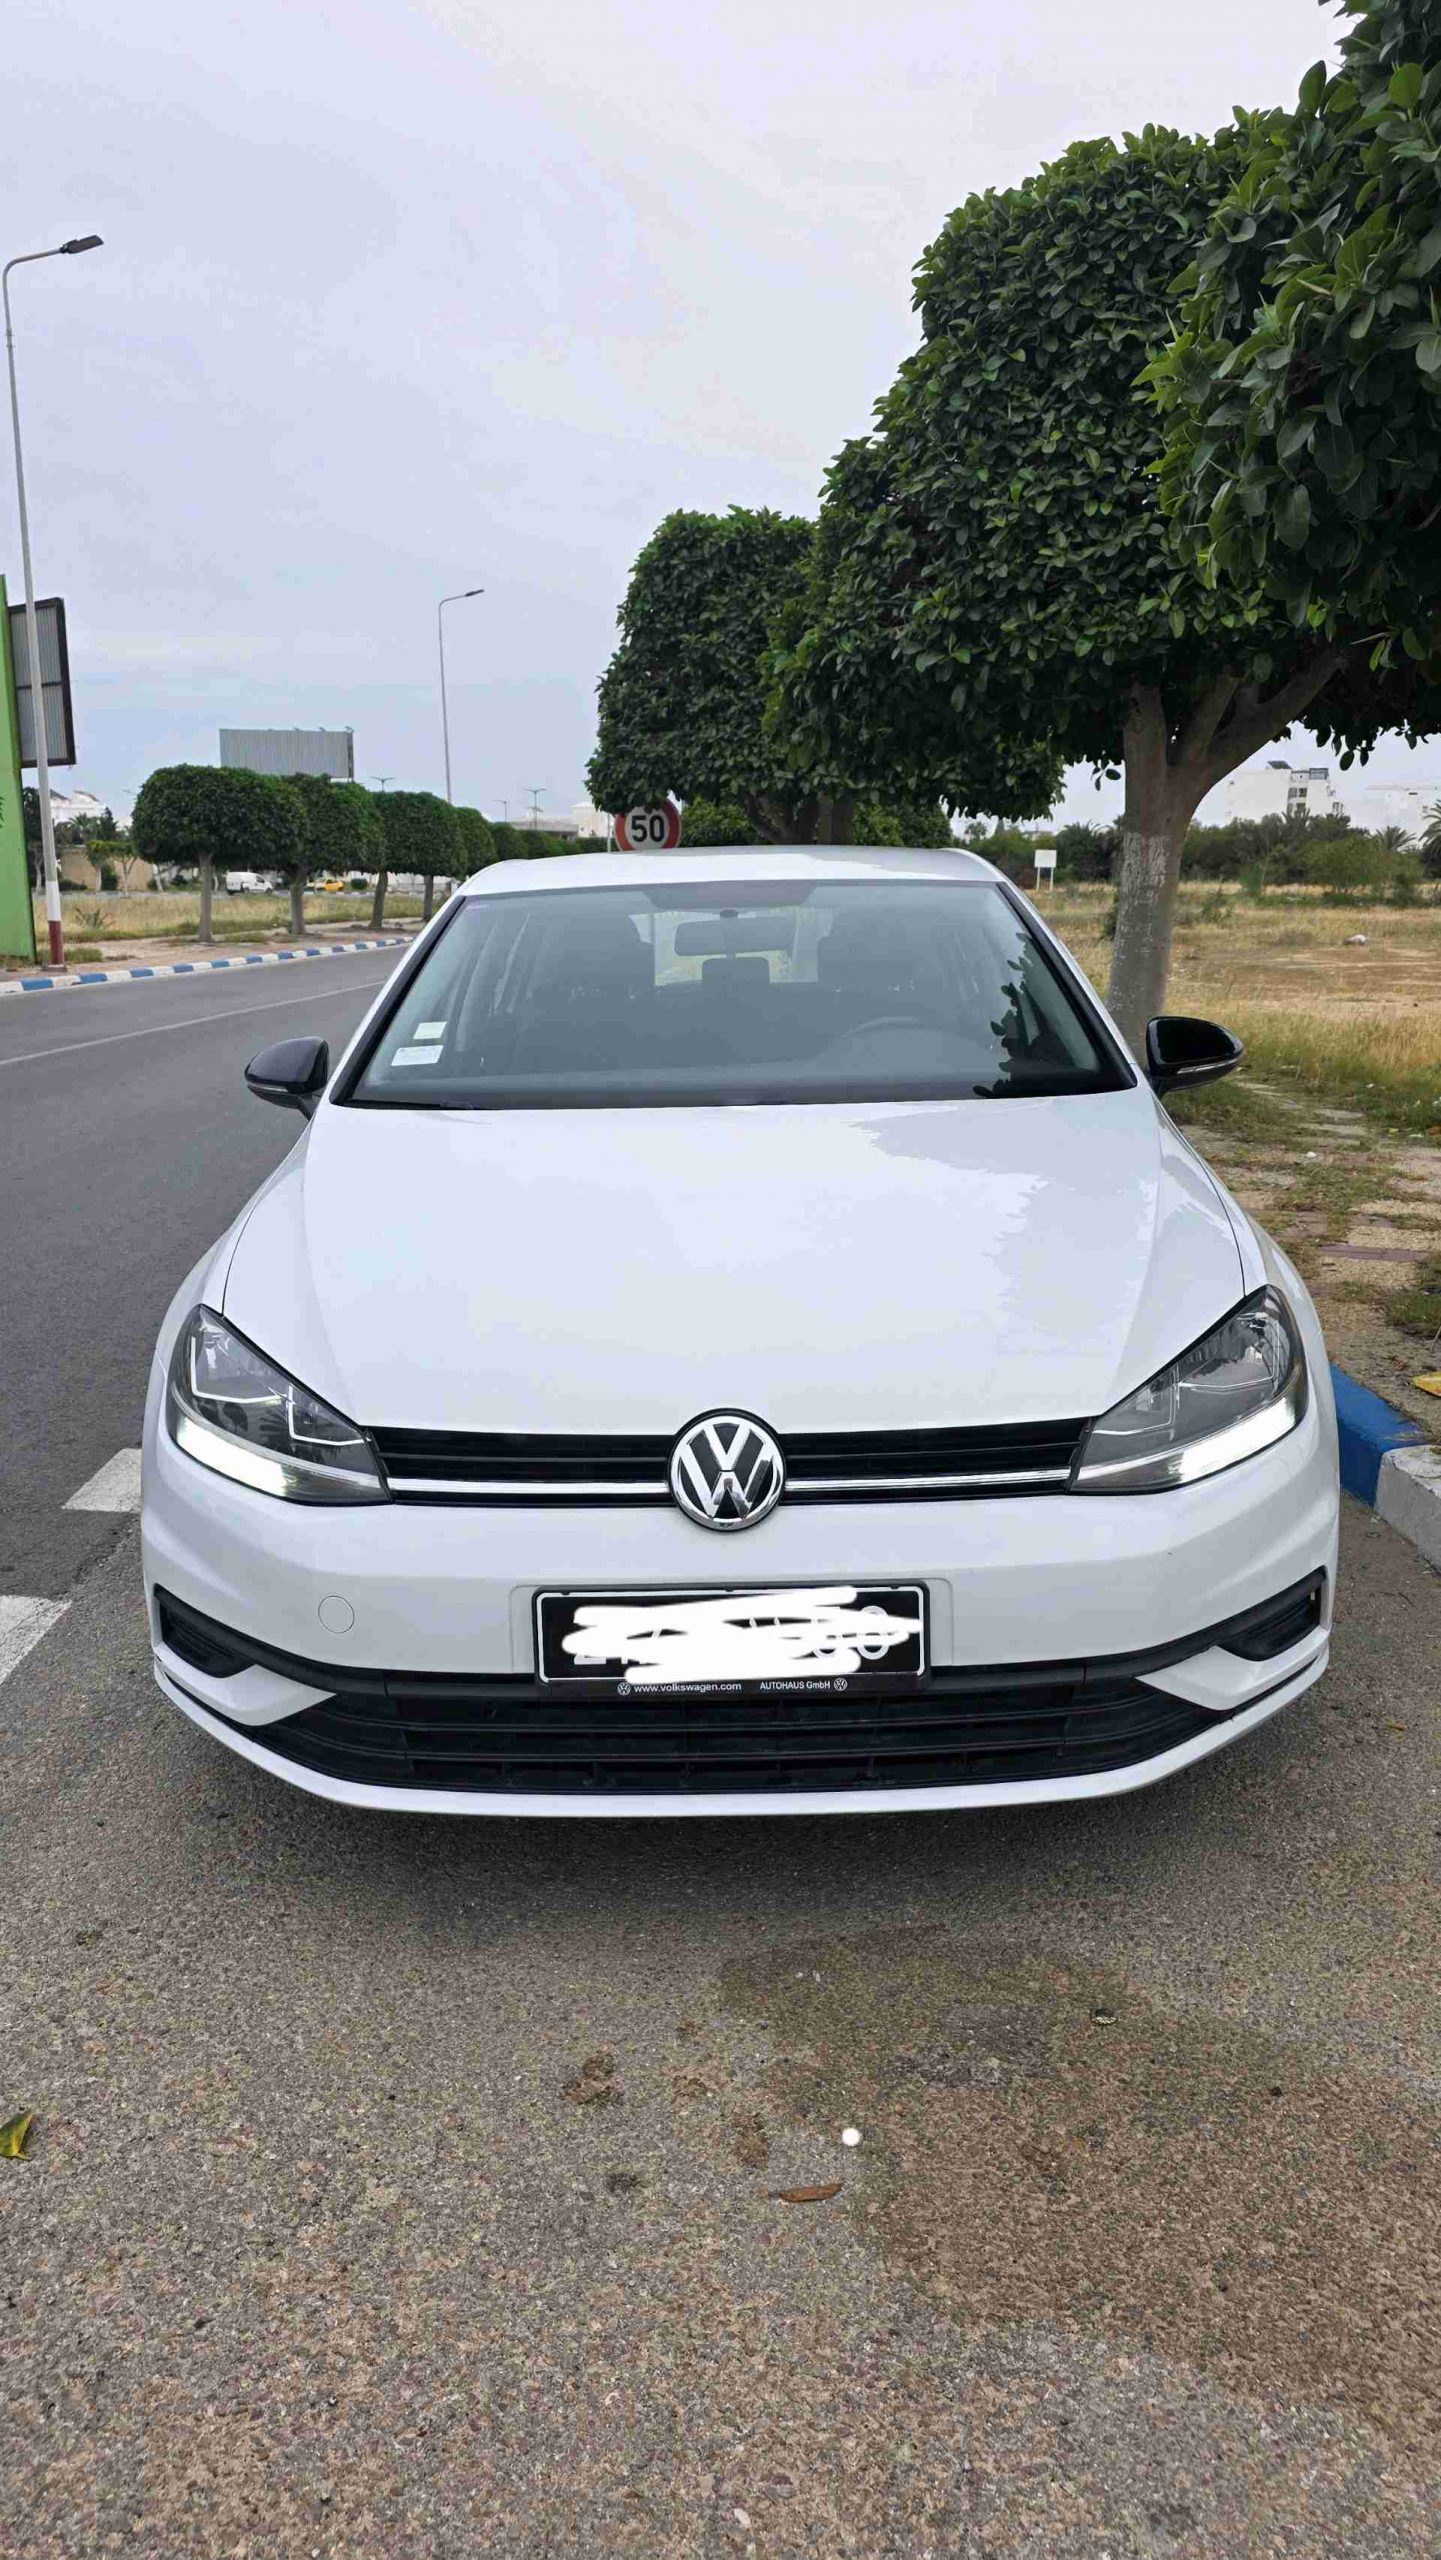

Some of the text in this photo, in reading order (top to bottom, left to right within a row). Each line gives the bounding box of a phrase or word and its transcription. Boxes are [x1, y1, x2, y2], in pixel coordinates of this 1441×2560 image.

[631, 814, 665, 843] 50
[633, 1683, 742, 1693] www.volkswagen.com
[760, 1681, 805, 1690] AUTOHAUS
[806, 1680, 831, 1689] GmbH
